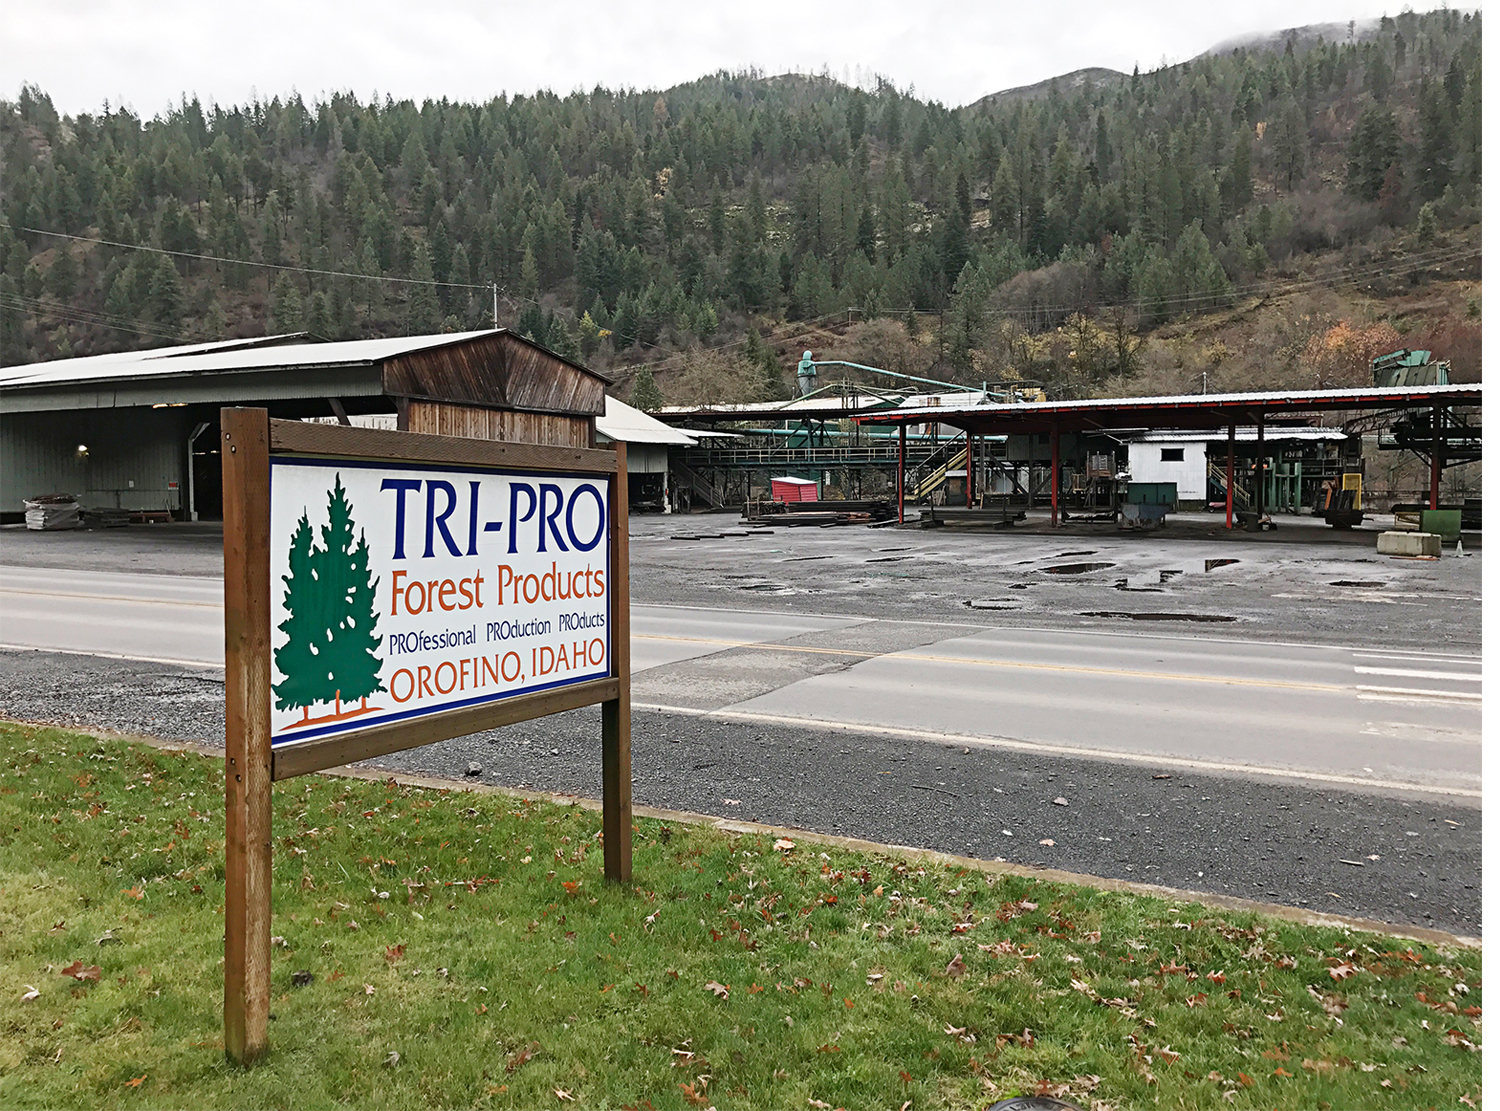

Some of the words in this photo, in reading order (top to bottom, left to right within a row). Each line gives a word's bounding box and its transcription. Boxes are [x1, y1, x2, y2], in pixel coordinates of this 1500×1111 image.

[380, 478, 605, 560] TRI-PRO
[390, 568, 485, 616] Forest
[498, 561, 605, 606] Products
[389, 624, 476, 655] PROfessional
[486, 618, 551, 643] PROduction
[558, 611, 605, 633] PROducts
[390, 650, 525, 703] OROFINO,
[532, 638, 605, 678] IDAHO
